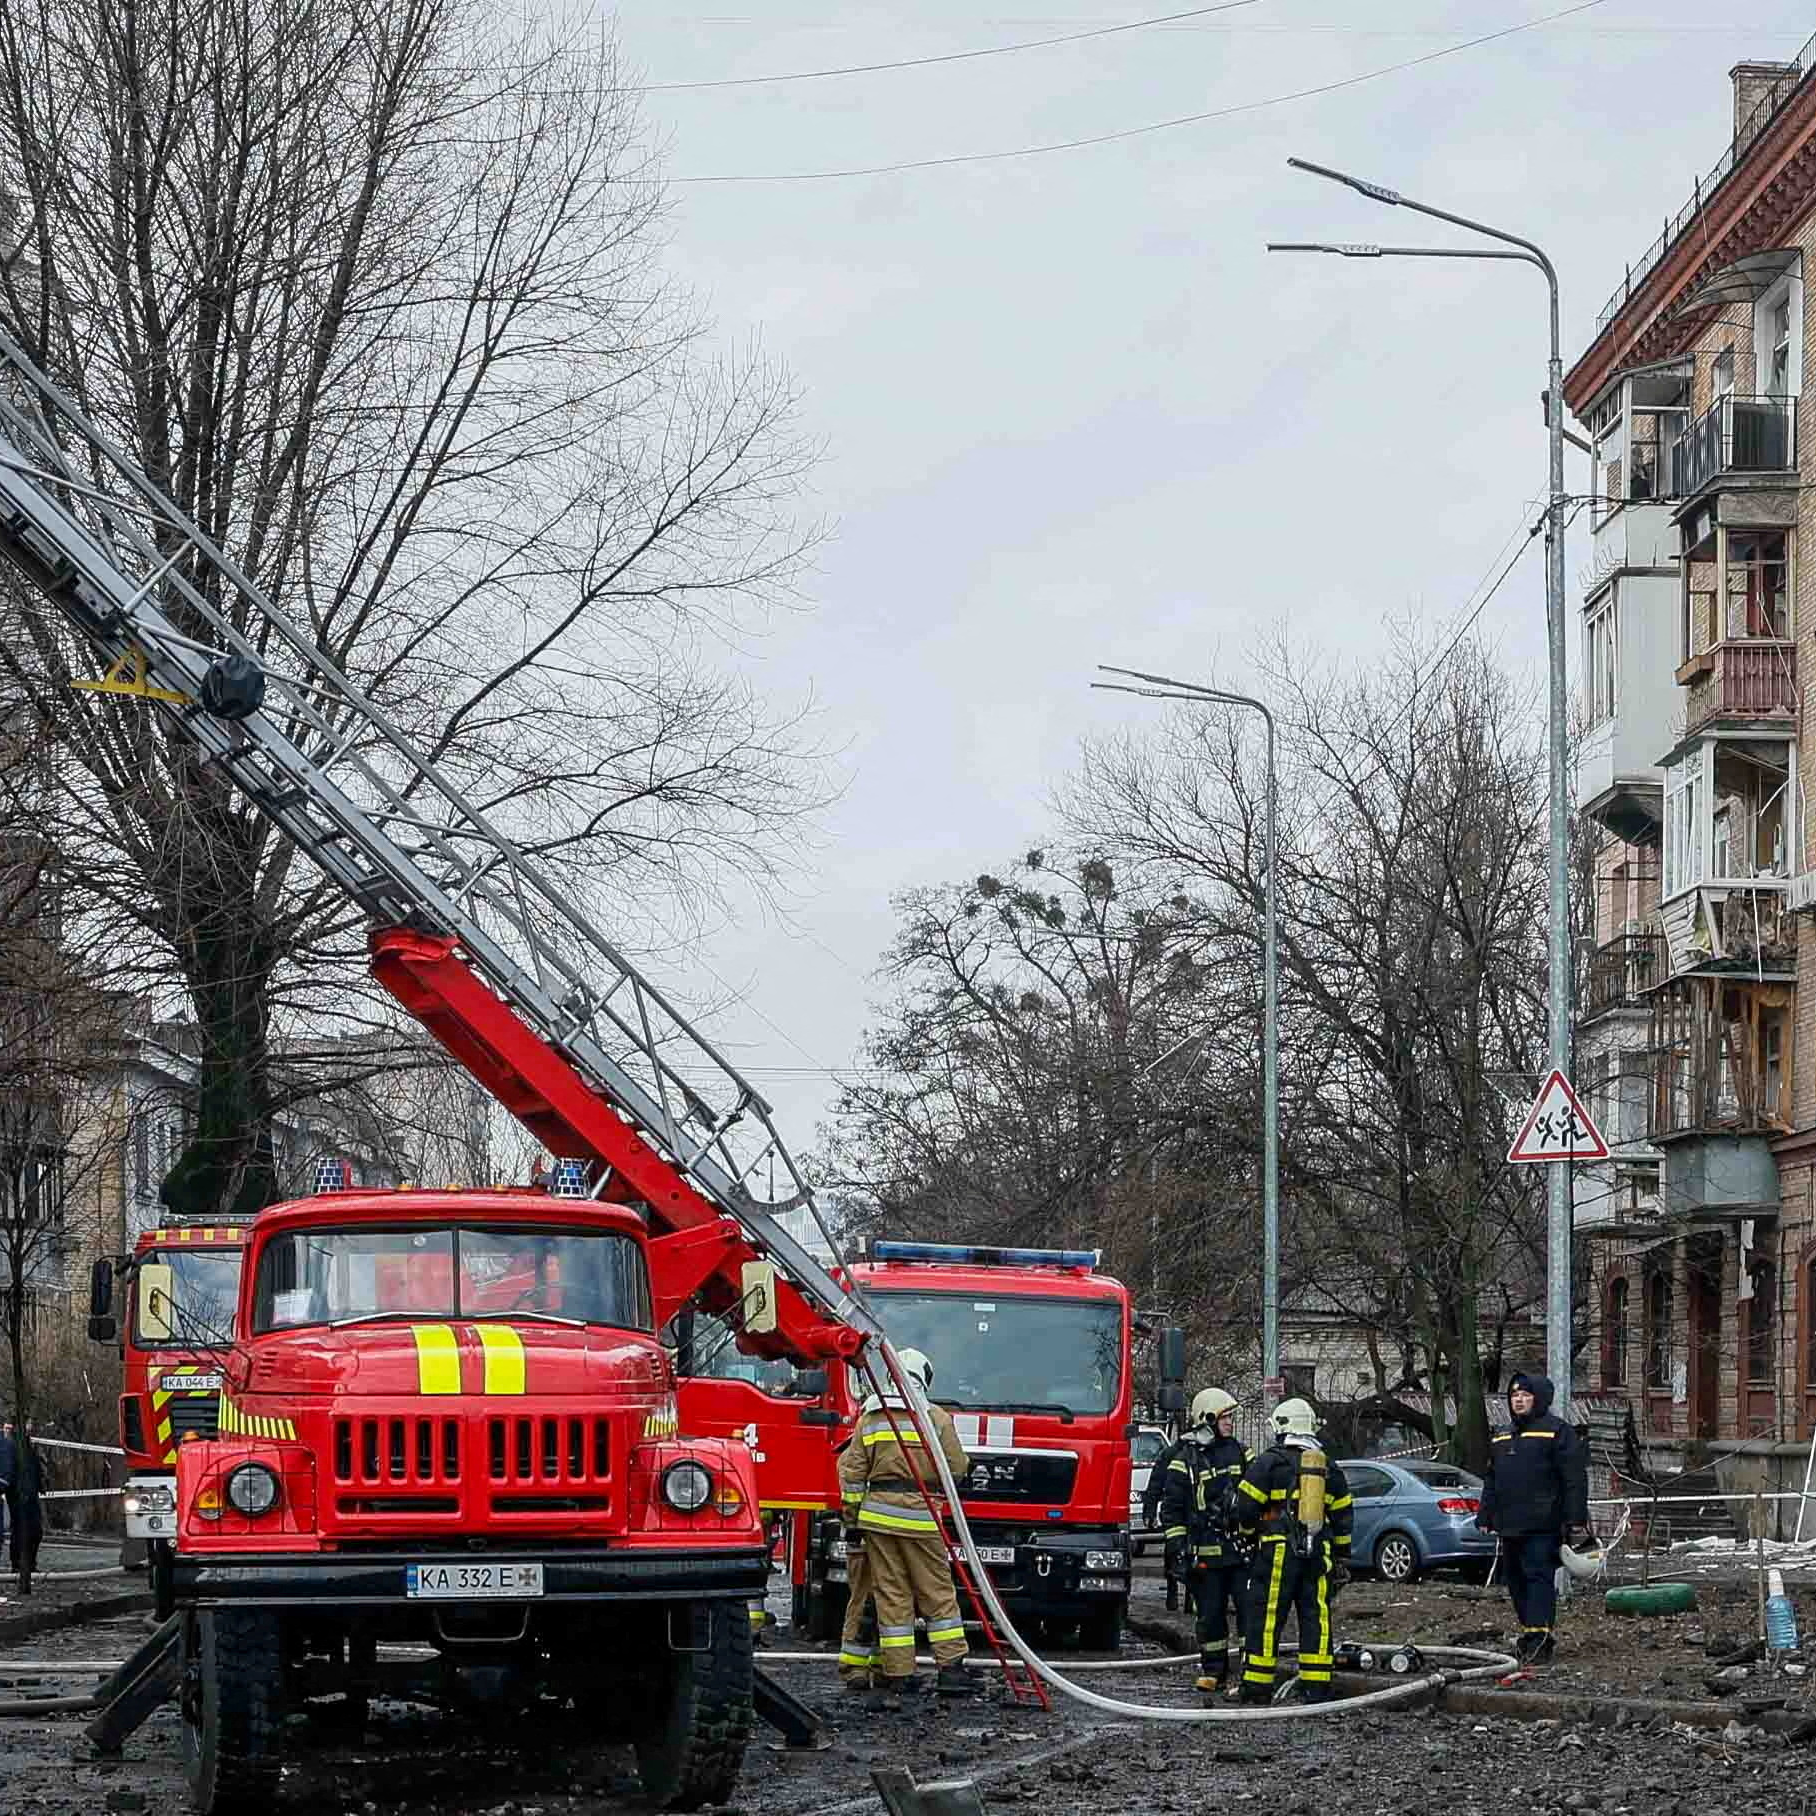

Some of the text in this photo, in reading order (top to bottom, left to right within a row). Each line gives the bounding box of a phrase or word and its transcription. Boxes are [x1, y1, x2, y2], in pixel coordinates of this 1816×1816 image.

[168, 1377, 183, 1388] KA
[207, 1377, 215, 1387] E
[421, 1568, 514, 1589] KA 332 E
